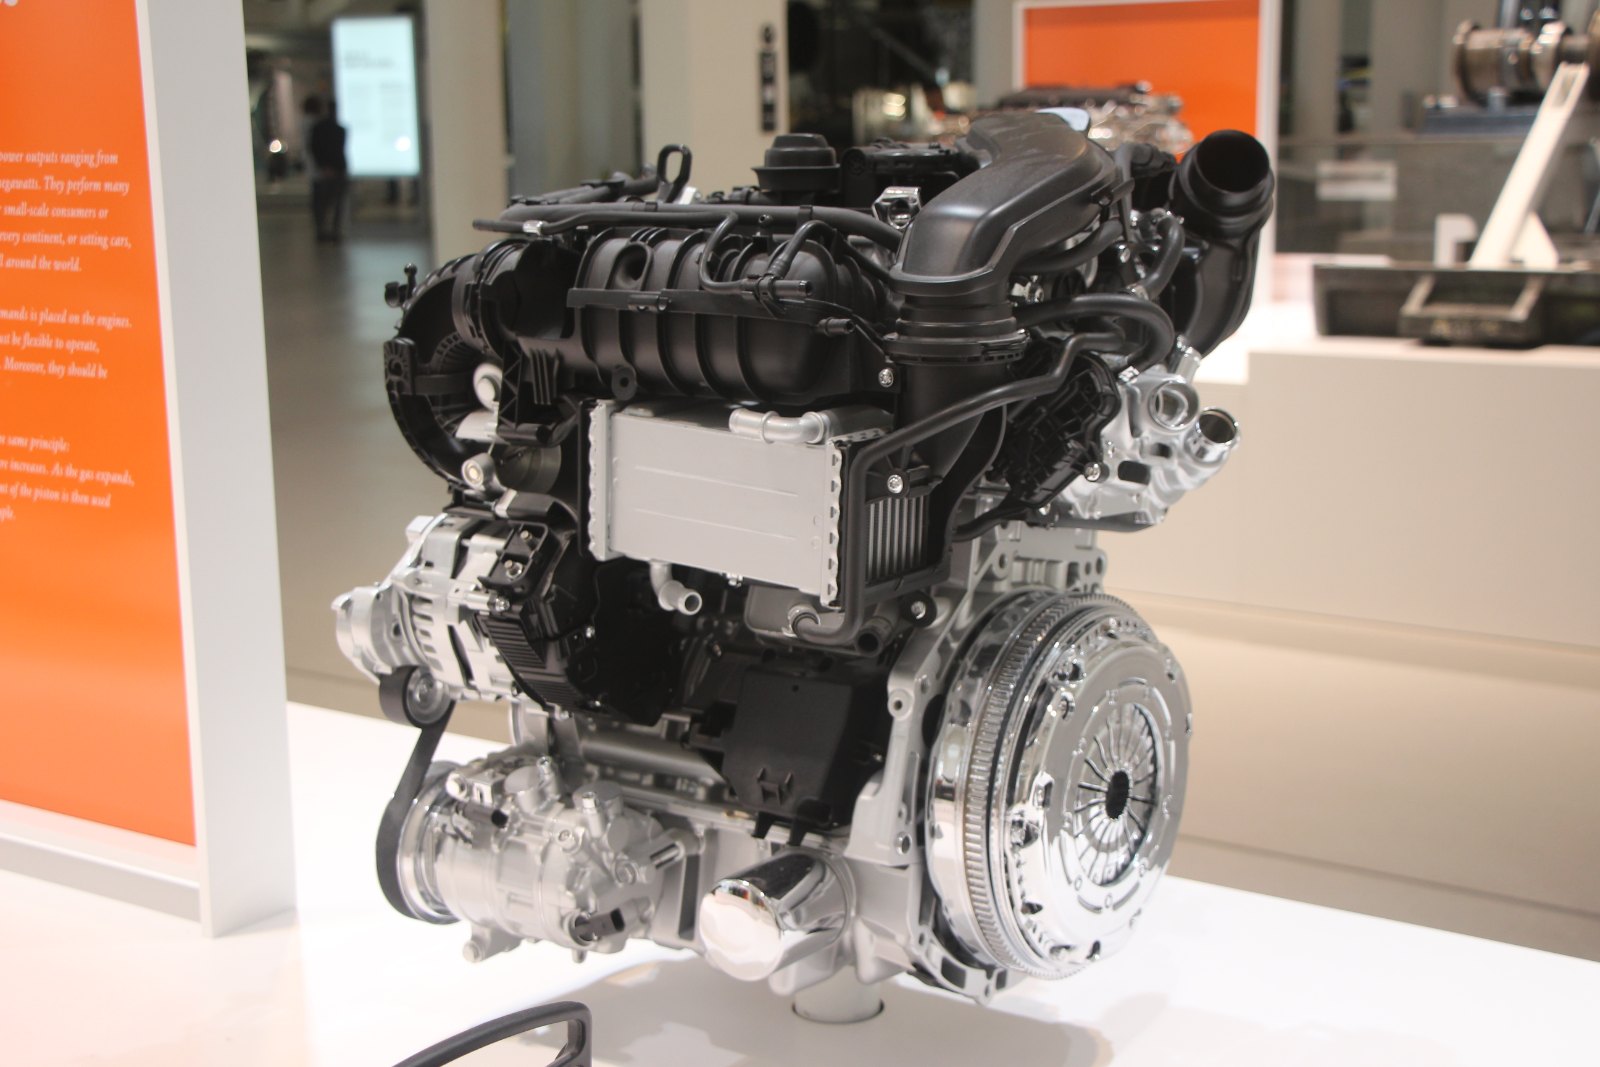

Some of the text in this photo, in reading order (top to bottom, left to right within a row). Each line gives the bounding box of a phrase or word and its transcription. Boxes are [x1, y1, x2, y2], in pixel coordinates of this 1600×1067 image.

[26, 151, 58, 167] outputs
[61, 149, 95, 168] ranging
[94, 149, 118, 168] from
[44, 175, 65, 195] They
[66, 176, 101, 195] perform
[104, 181, 130, 196] many
[4, 201, 49, 217] small-scale
[52, 207, 96, 219] consumers
[98, 208, 109, 218] or
[0, 231, 132, 250] every continent, or setting cars,
[5, 254, 36, 269] around
[38, 255, 51, 270] the
[53, 256, 82, 272] world.
[30, 308, 37, 320] is
[39, 307, 67, 325] placed
[68, 313, 80, 324] on
[82, 310, 95, 325] the
[97, 313, 133, 331] engines.
[12, 331, 21, 346] be
[21, 331, 52, 350] flexible
[55, 337, 64, 349] to
[65, 338, 99, 354] operate,
[4, 356, 108, 379] Moreover, they should be
[7, 436, 28, 448] same
[29, 436, 70, 454] principle:
[10, 457, 48, 475] increases.
[51, 461, 63, 477] As
[65, 463, 78, 479] the
[79, 469, 94, 483] gas
[96, 469, 135, 487] expands,
[9, 481, 20, 499] of
[20, 482, 32, 498] the
[33, 485, 60, 503] piston
[61, 487, 69, 502] is
[70, 488, 89, 505] then
[91, 493, 112, 509] used
